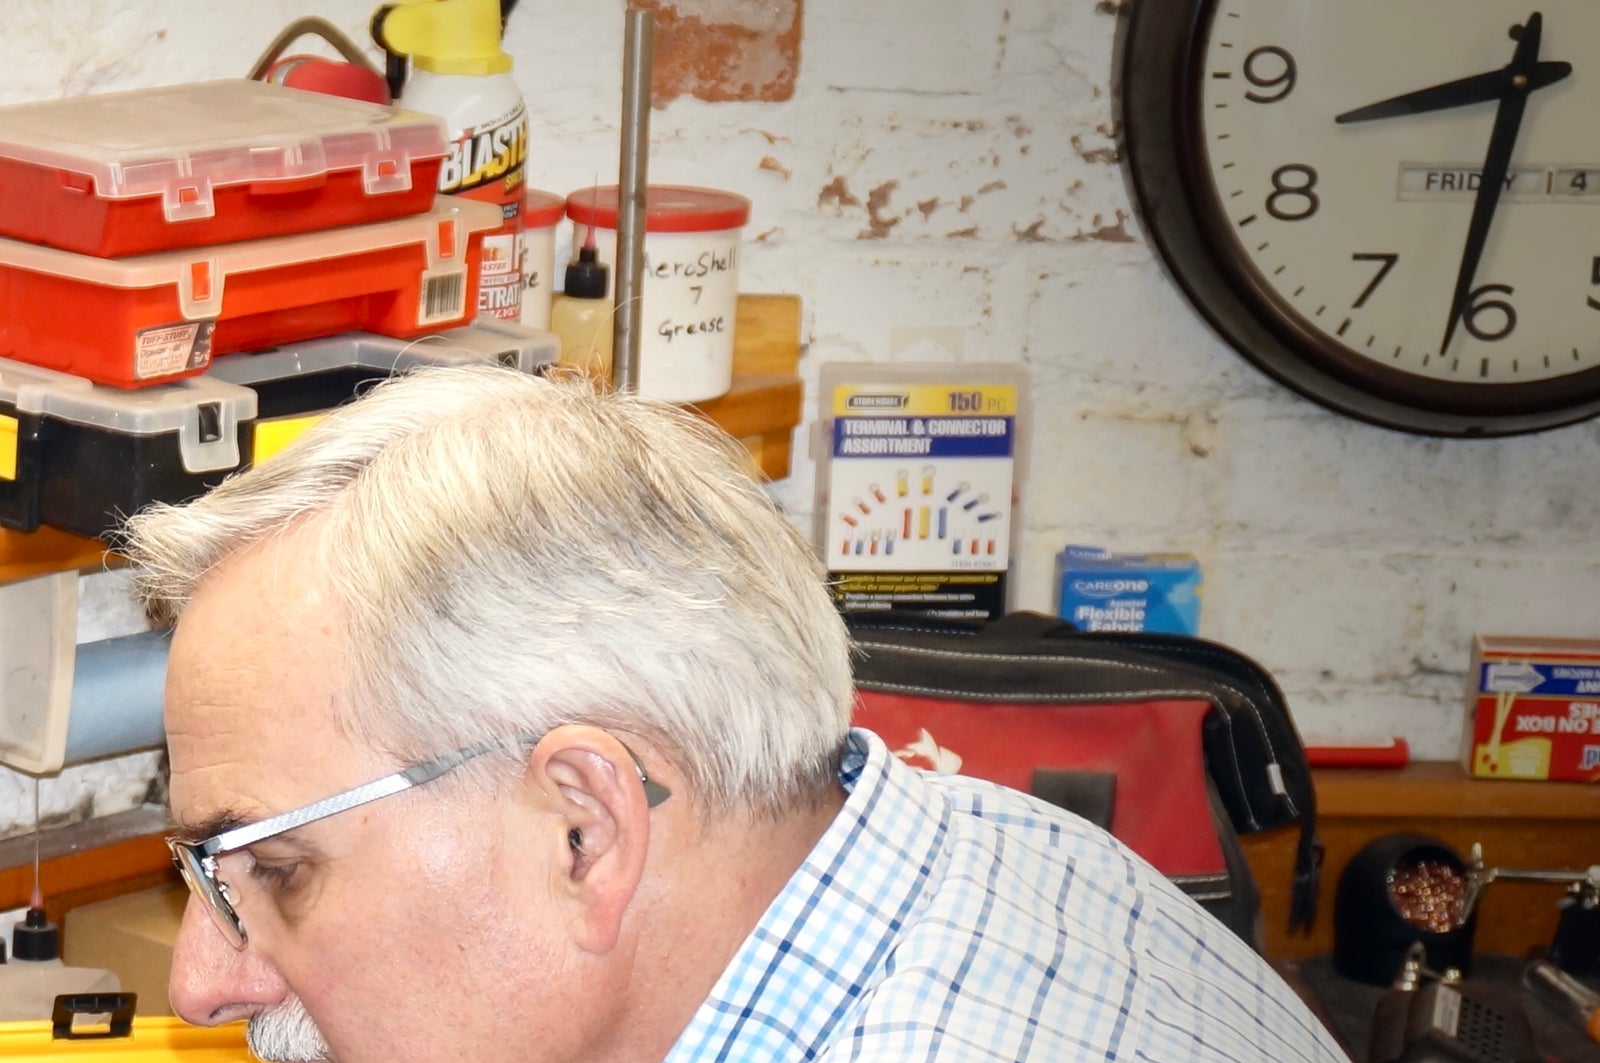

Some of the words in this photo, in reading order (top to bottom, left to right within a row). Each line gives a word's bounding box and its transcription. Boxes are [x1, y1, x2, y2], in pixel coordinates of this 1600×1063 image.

[1244, 46, 1297, 104] 9
[1425, 172, 1516, 191] FRIDY
[1266, 163, 1319, 221] 8
[1352, 253, 1398, 309] 7
[690, 285, 703, 305] 7
[1463, 284, 1517, 341] 6
[658, 316, 724, 342] Grease
[844, 419, 910, 435] TERMINAL
[912, 419, 925, 435] &
[928, 419, 1007, 436] CONNECTOR
[843, 438, 932, 453] ASSORTMENT
[1079, 606, 1145, 621] Flexible
[1516, 715, 1555, 733] BOX
[1558, 716, 1589, 734] ON
